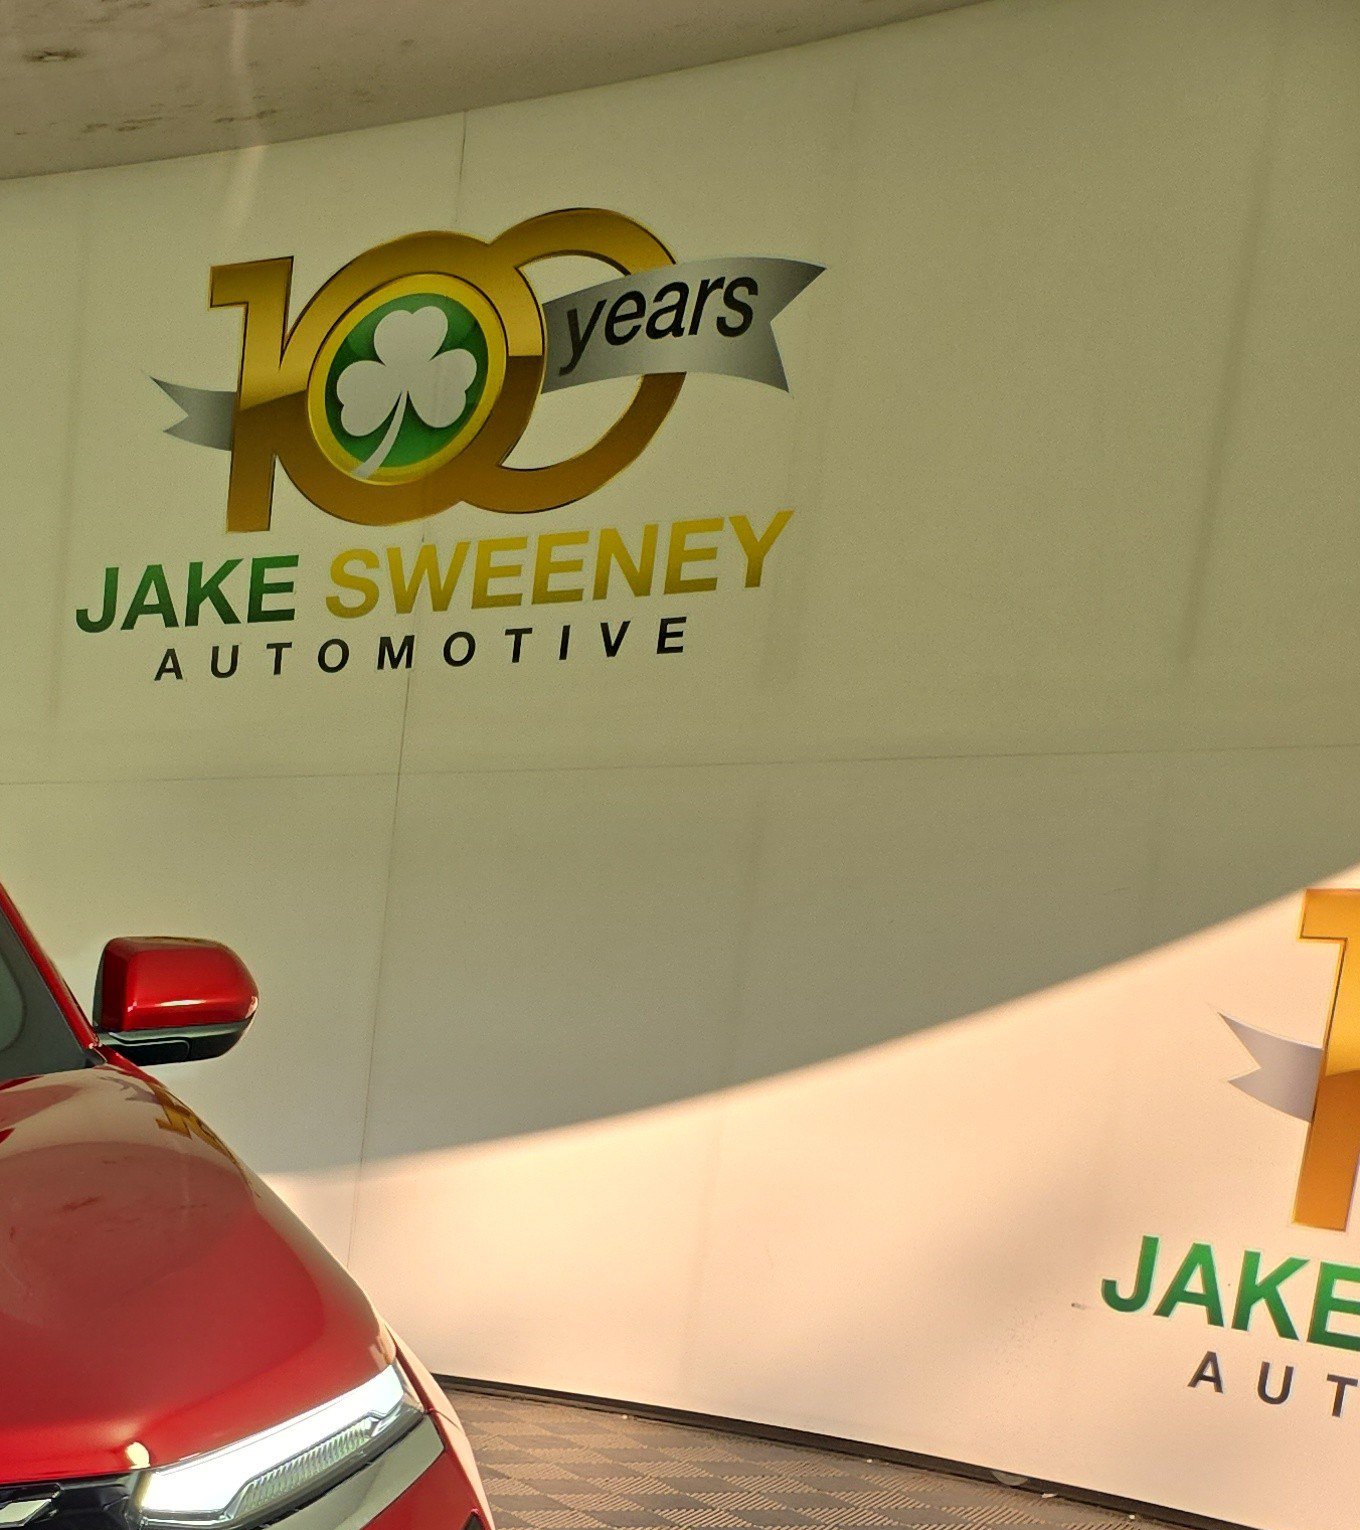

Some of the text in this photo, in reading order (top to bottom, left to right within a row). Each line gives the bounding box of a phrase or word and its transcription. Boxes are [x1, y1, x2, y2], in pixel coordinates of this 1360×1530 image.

[557, 276, 759, 376] years
[75, 510, 795, 634] JAKE SWEENEY
[153, 616, 688, 682] AUTOMOTIVE
[1100, 1234, 1360, 1352] JAKE
